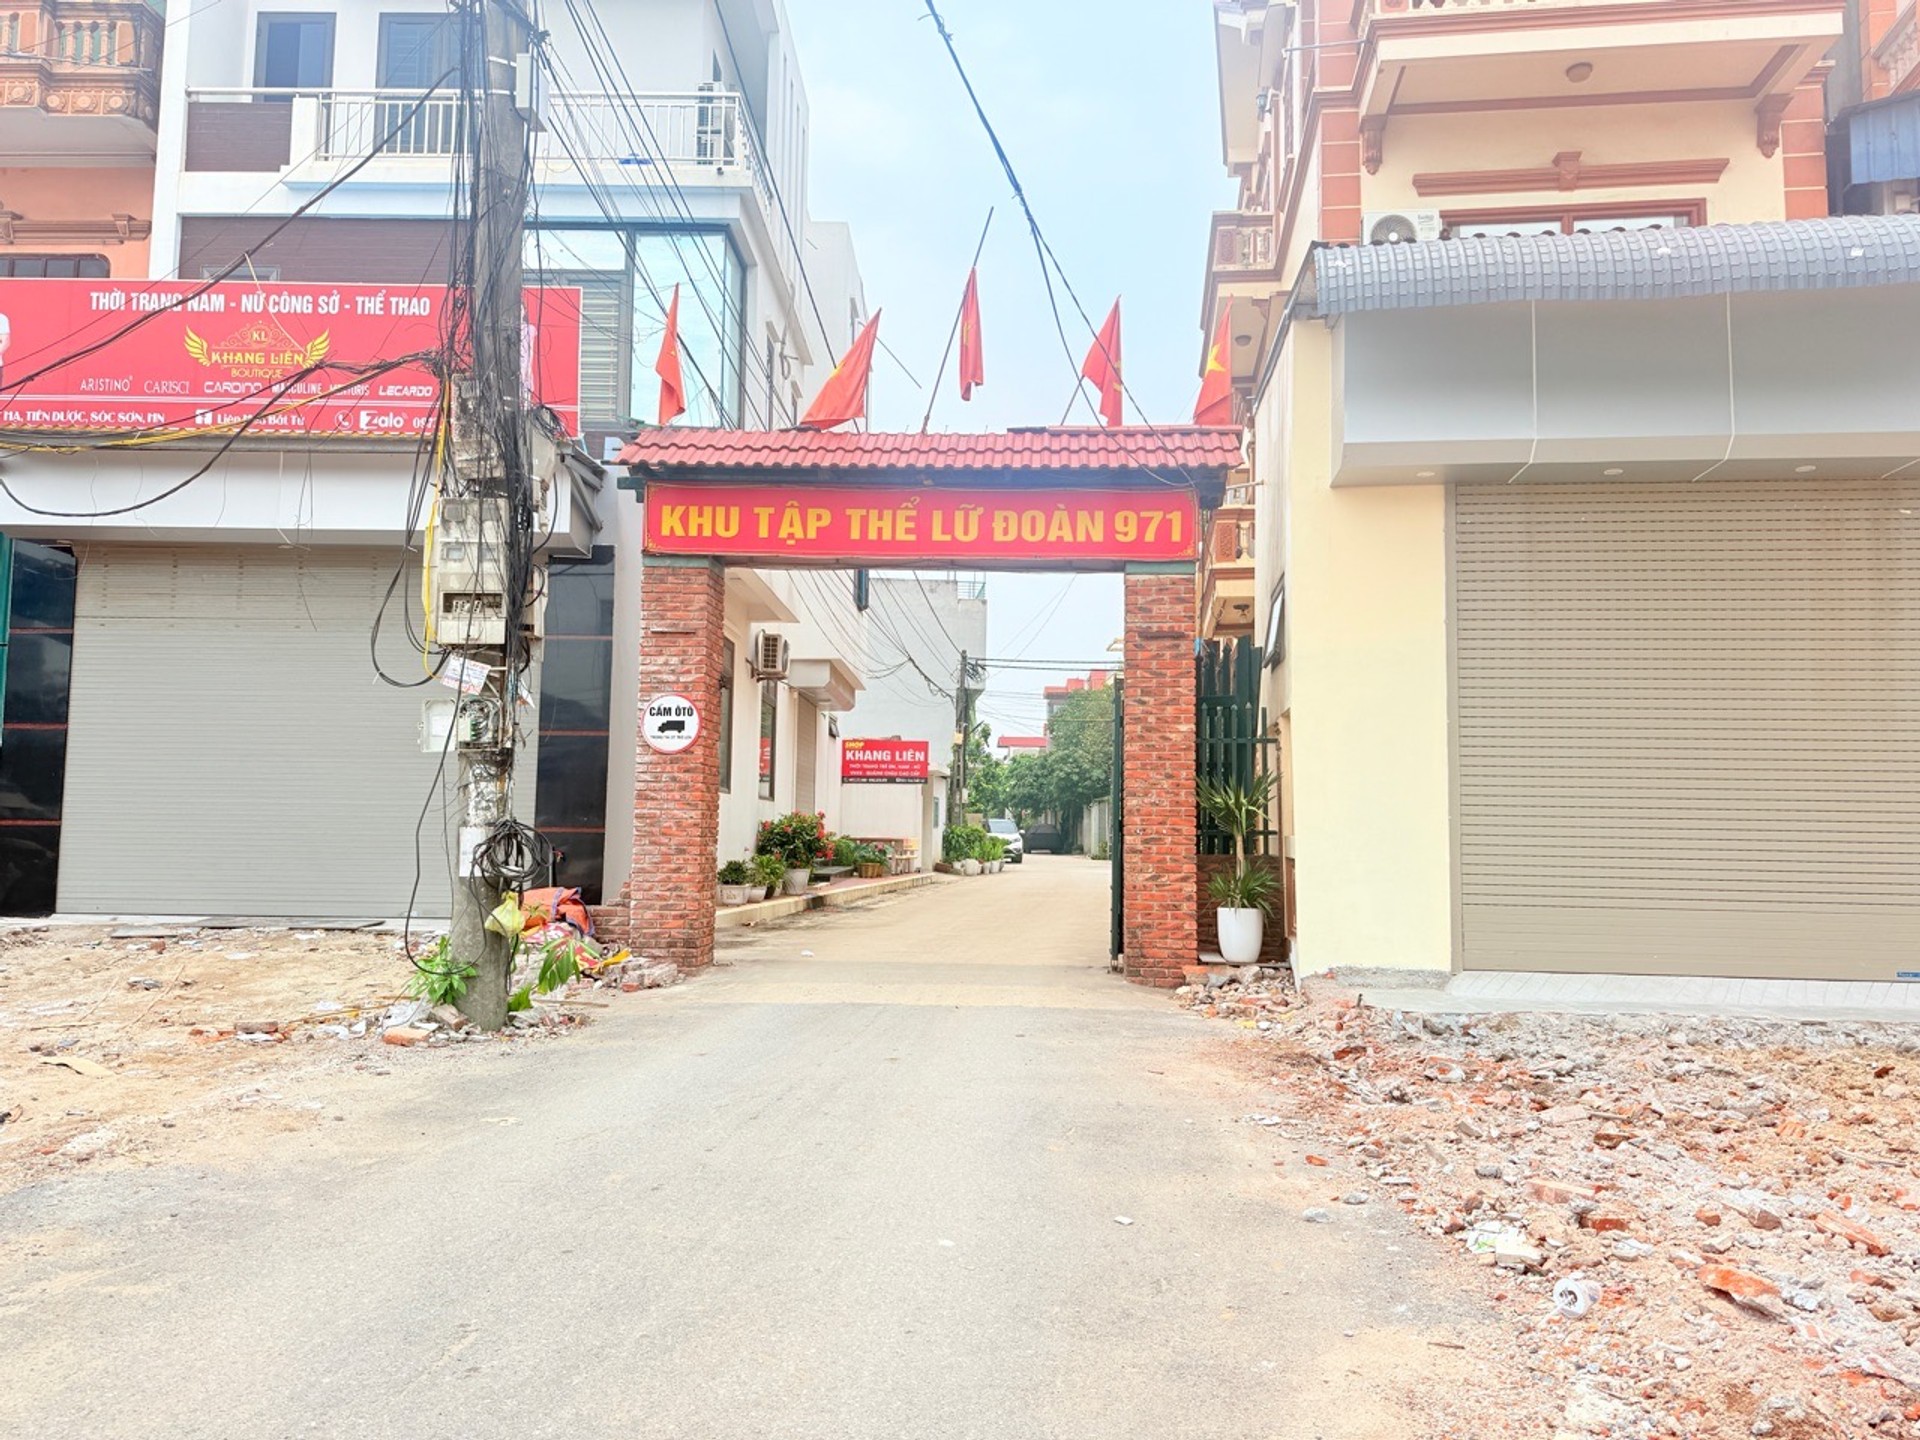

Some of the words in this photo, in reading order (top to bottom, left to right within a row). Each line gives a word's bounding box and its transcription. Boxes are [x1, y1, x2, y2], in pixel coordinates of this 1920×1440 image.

[90, 288, 125, 311] THỜI
[131, 293, 183, 311] TRANG
[187, 293, 225, 312] NAM
[240, 290, 266, 312] NỮ
[269, 291, 313, 314] CÔNG
[318, 290, 340, 314] SỞ
[356, 289, 387, 315] THỂ
[390, 297, 431, 316] THAO
[252, 330, 267, 340] KL
[211, 351, 265, 364] KHANG
[270, 350, 304, 365] LIÊN
[231, 367, 283, 379] BOUTIQUE
[79, 378, 131, 392] ARISTINO
[144, 380, 190, 394] CARISCI
[203, 381, 263, 394] CARDINO
[378, 385, 433, 397] LECARDO
[26, 409, 50, 422] TIÊN
[52, 411, 88, 424] DƯỢC,
[90, 410, 116, 423] SÓC
[117, 411, 145, 424] SƠN,
[661, 505, 740, 539] KHU
[753, 501, 832, 546] TẬP
[846, 496, 921, 542] THỂ
[932, 503, 986, 543] LỮ
[992, 503, 1105, 543] ĐOÀN
[1115, 510, 1183, 543] 971
[649, 704, 672, 717] CẤM
[675, 705, 694, 717] ÔTÔ
[845, 741, 865, 749] SHOP
[846, 750, 892, 761] KHANG
[895, 748, 925, 761] LIÊN
